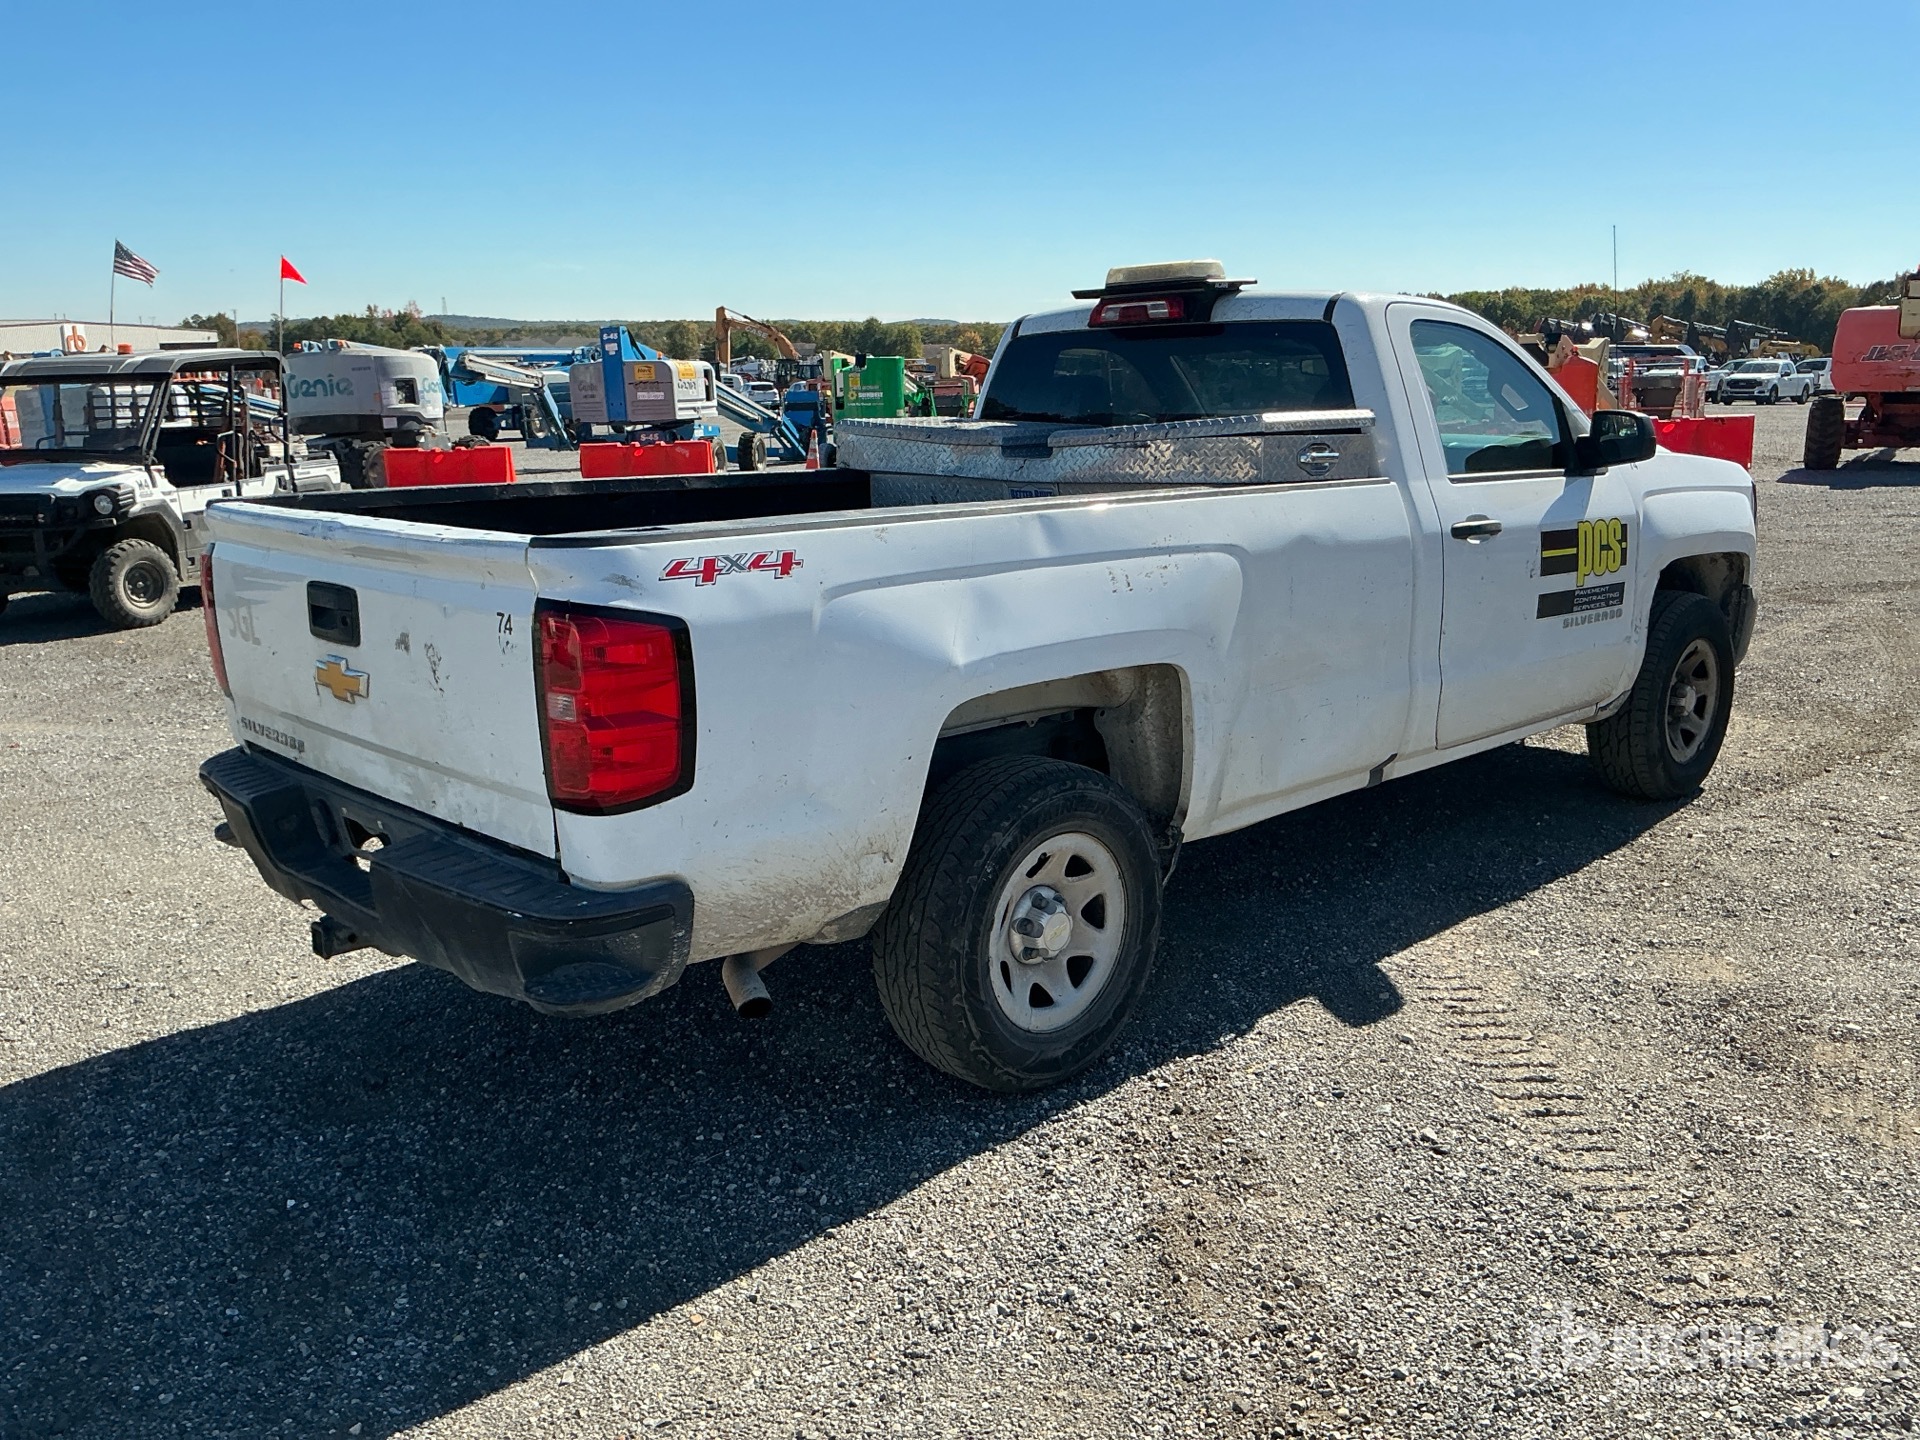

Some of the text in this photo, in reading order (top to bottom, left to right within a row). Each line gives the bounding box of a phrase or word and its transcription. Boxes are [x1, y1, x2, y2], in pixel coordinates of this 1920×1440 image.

[66, 325, 87, 352] rb
[602, 332, 619, 340] S-45
[745, 325, 769, 339] CASE
[285, 373, 354, 399] Genie
[639, 433, 659, 441] S-45
[1573, 591, 1620, 604] CONTRACTING
[1574, 586, 1610, 597] PAVEMENT
[496, 611, 513, 636] 74
[1562, 608, 1624, 630] SILVERADO
